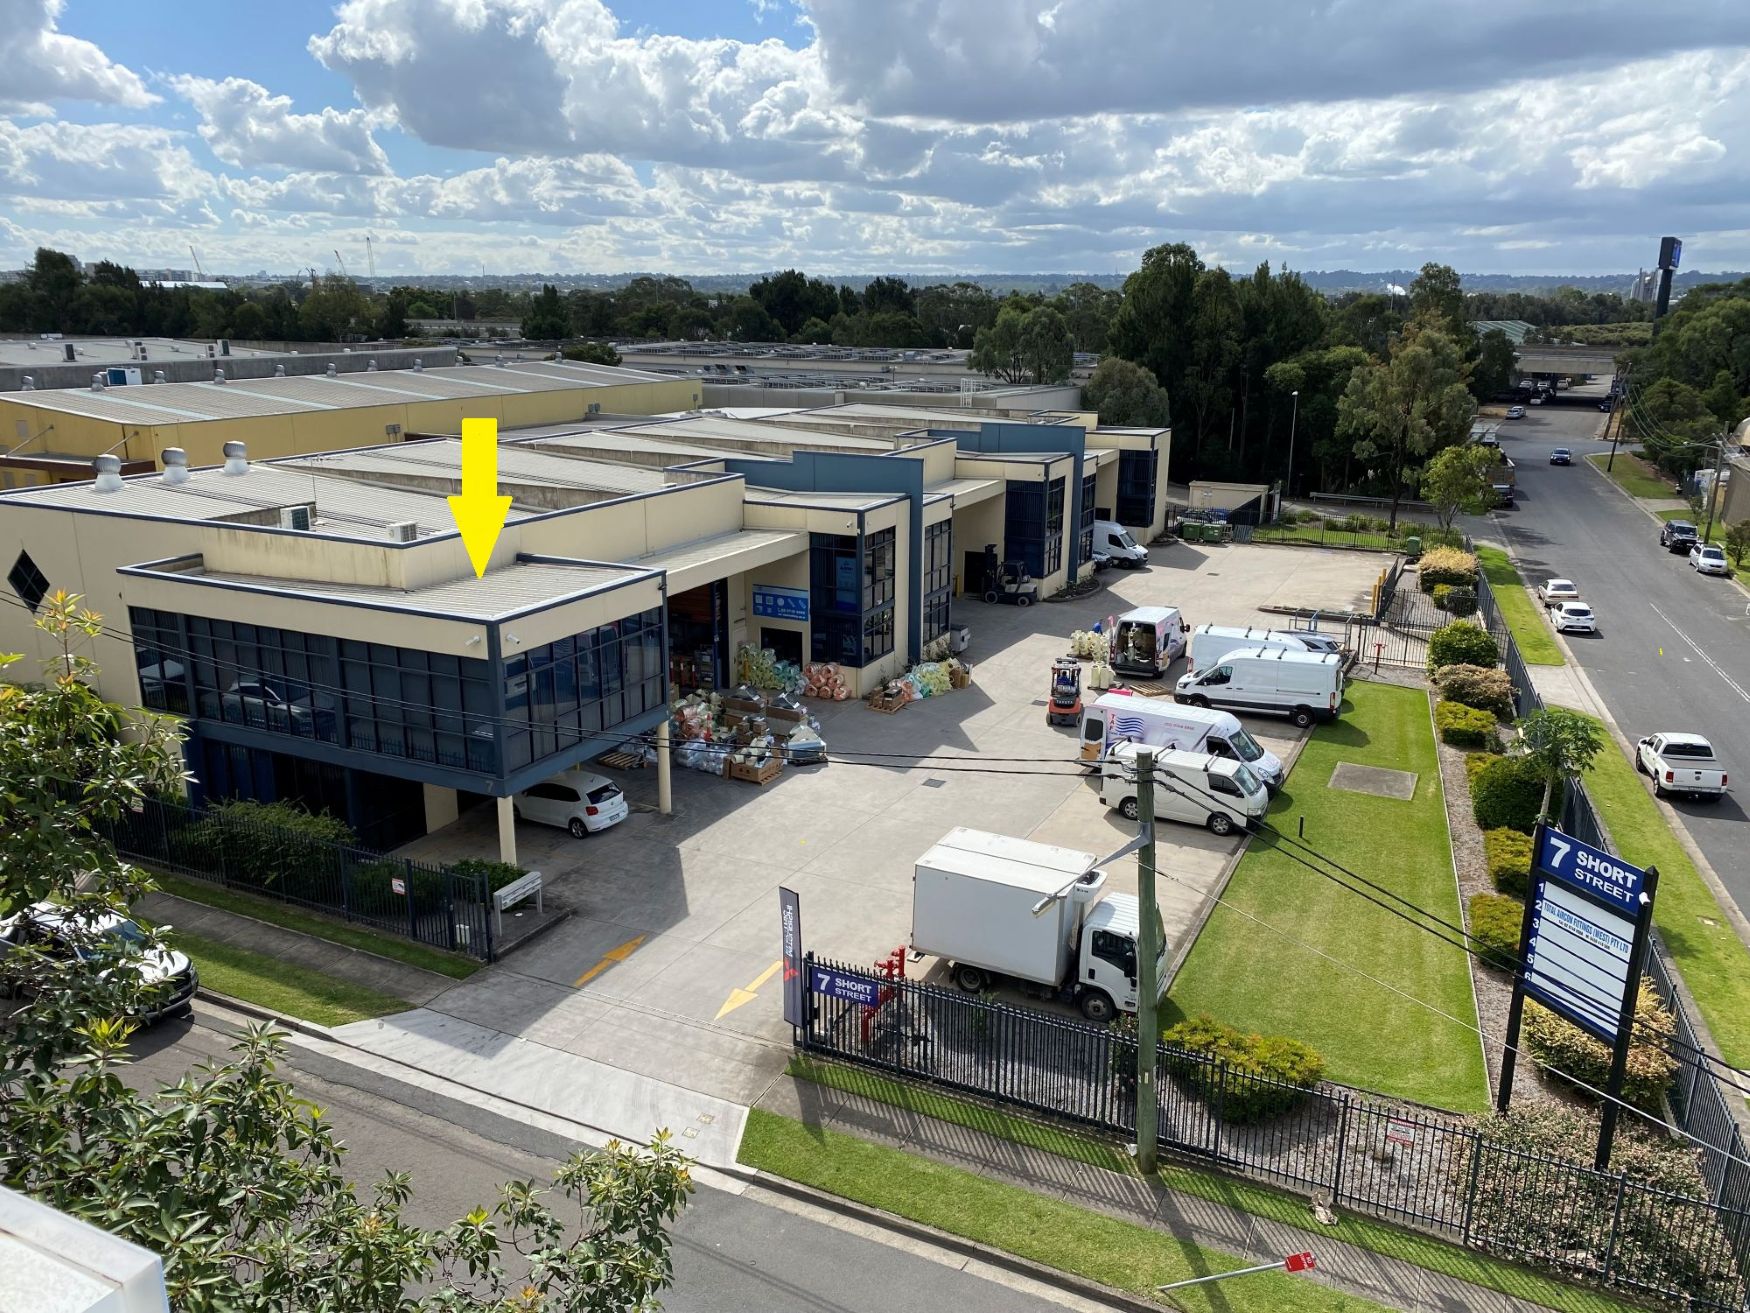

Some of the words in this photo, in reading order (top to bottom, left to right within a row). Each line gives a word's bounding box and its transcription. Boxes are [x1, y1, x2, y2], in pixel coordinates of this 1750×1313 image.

[1549, 836, 1571, 869] 7
[1577, 851, 1637, 888] SHORT
[1538, 882, 1545, 893] 1
[1574, 868, 1634, 903] STREET
[1534, 899, 1543, 911] 2
[1532, 918, 1540, 929] 3
[1528, 936, 1537, 947] 4
[1526, 953, 1535, 964] 5
[1523, 971, 1532, 982] 6
[817, 972, 831, 991] 7
[834, 977, 872, 994] SHORT
[834, 987, 872, 1002] STREET
